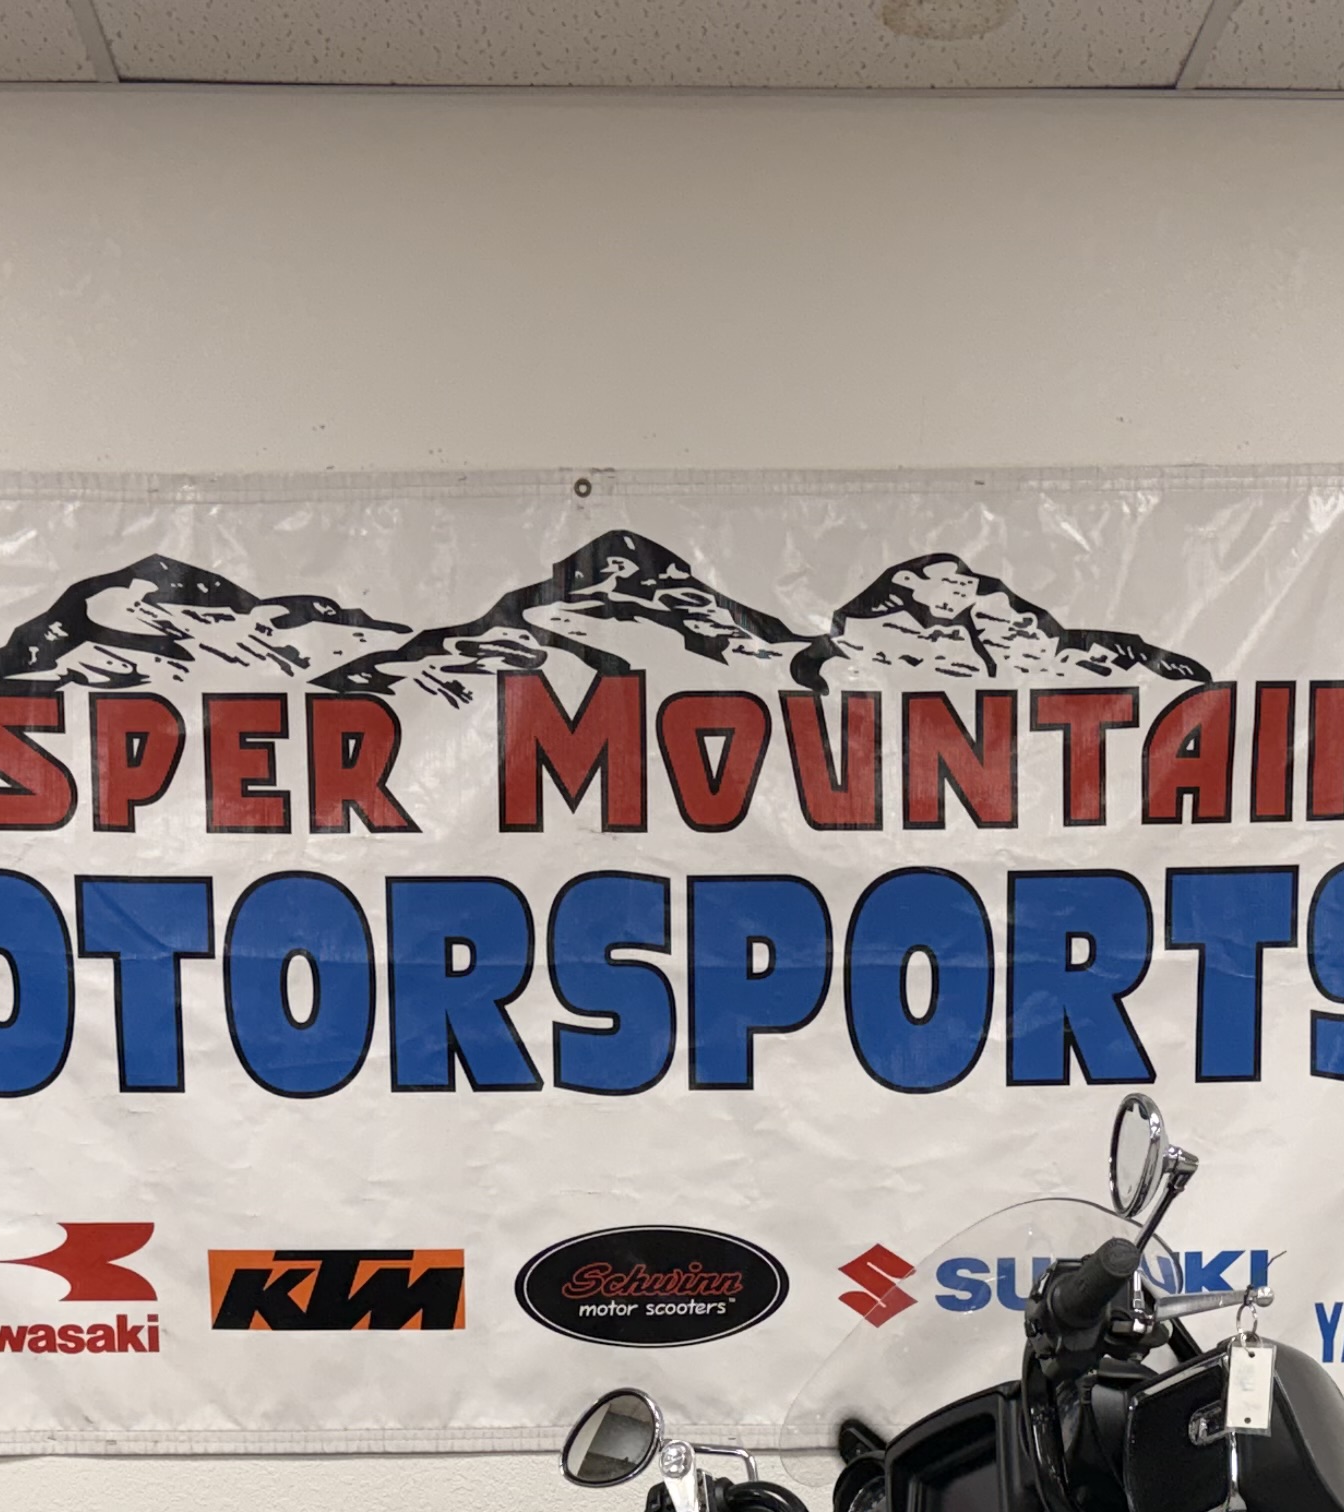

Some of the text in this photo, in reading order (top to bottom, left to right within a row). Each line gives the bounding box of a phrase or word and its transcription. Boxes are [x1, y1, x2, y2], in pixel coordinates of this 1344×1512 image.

[210, 1249, 465, 1331] KTM
[561, 1261, 744, 1299] Schwinn
[934, 1249, 1269, 1312] SUKI
[579, 1298, 726, 1317] motor scooters
